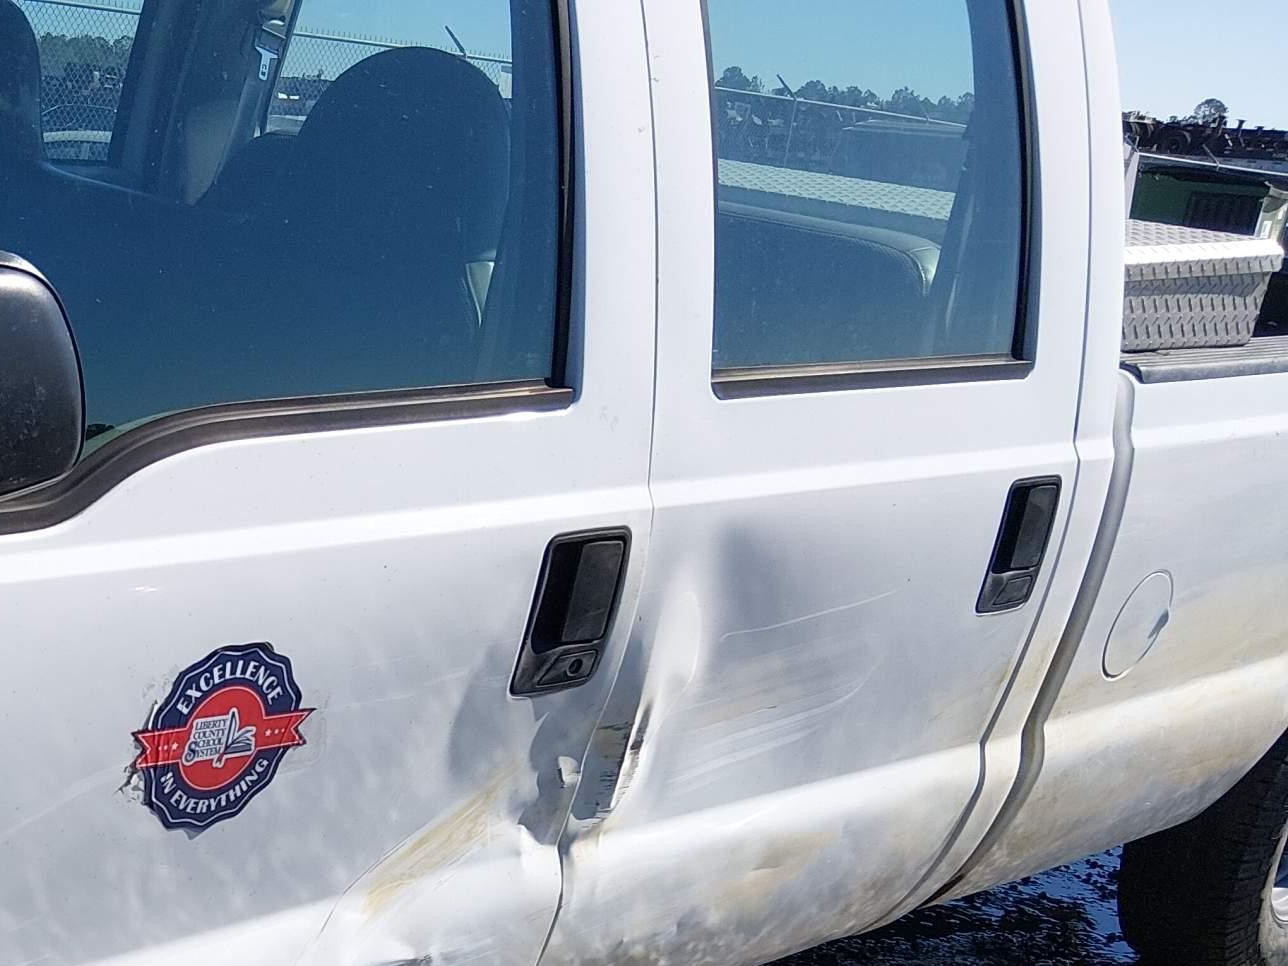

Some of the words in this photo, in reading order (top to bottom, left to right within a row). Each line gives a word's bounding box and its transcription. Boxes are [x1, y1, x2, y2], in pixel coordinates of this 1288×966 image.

[176, 659, 283, 715] EXCELLENCE
[193, 728, 226, 740] COUNTY
[195, 719, 227, 730] LIBERTY
[160, 771, 175, 795] IN
[170, 757, 268, 814] EVERYTHING
